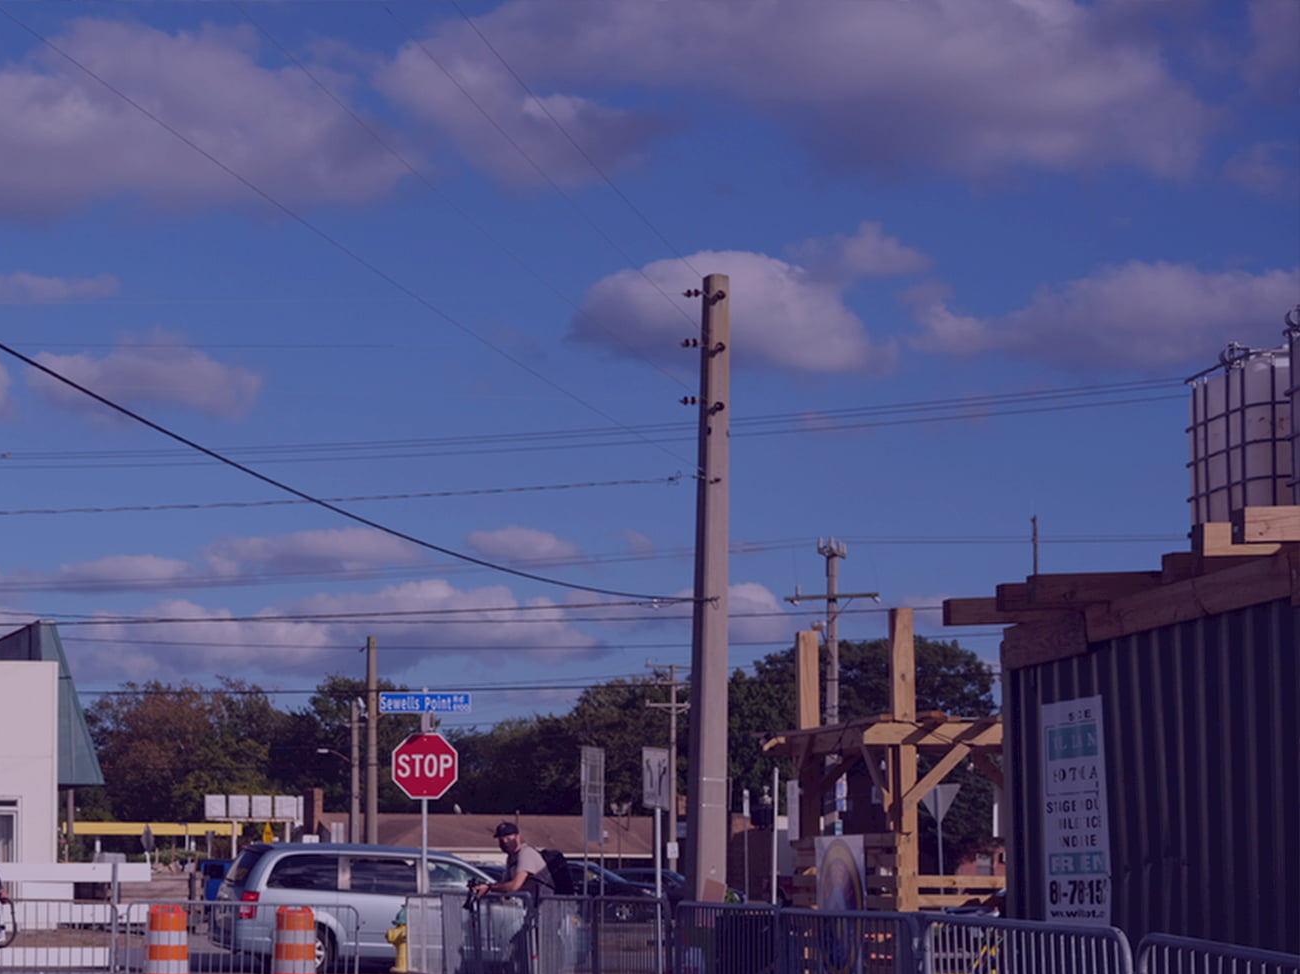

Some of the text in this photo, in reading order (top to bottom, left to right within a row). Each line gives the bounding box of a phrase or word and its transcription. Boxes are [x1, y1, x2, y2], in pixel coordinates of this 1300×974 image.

[380, 696, 420, 710] Sewells
[424, 695, 452, 711] Point
[397, 753, 453, 778] STOP
